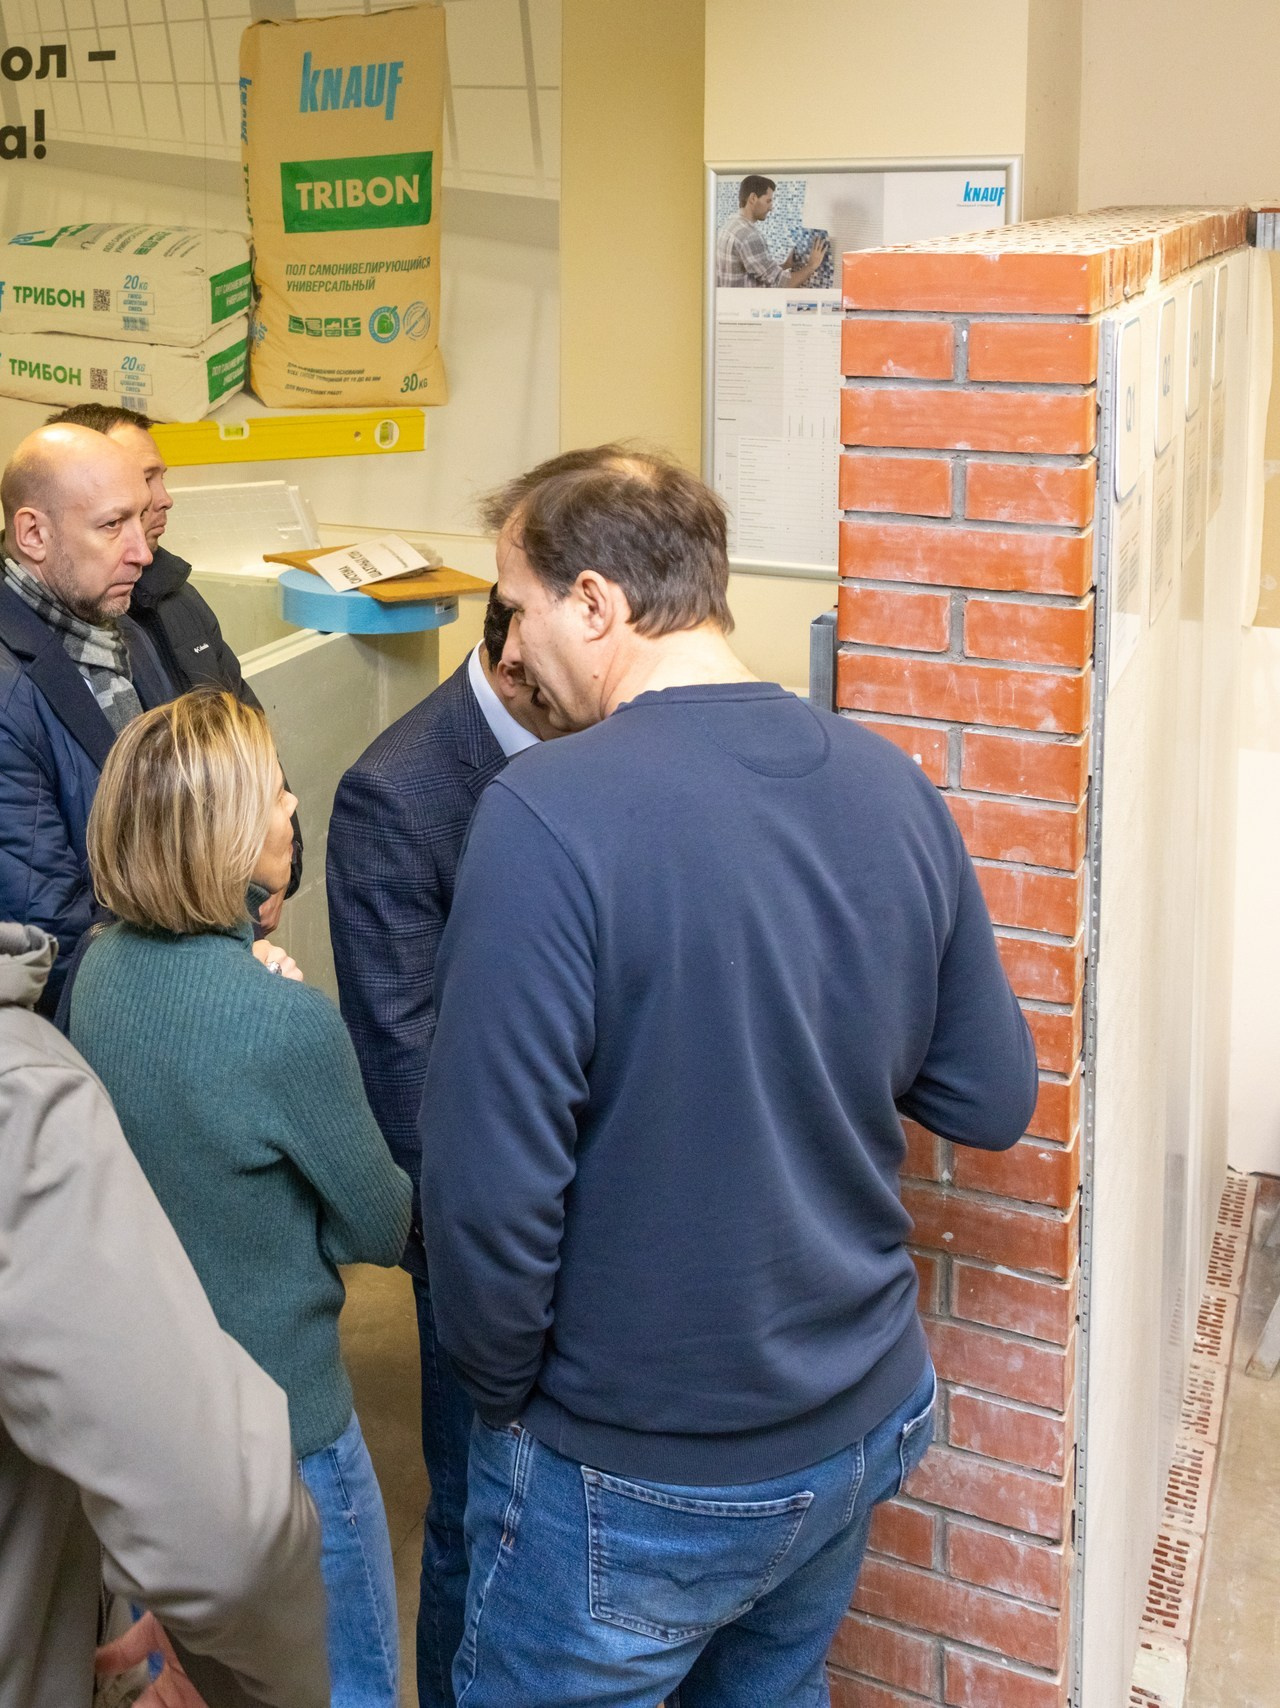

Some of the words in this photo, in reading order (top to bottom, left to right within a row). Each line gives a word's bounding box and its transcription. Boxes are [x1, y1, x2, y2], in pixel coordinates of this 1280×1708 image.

[299, 51, 404, 120] KNAUF
[295, 174, 419, 211] TRIBON
[963, 181, 1006, 207] KNAUF
[285, 264, 307, 276] ПОЛ
[309, 256, 431, 276] САМОНИВЕЛИРУЮЩИЙСЯ
[123, 275, 139, 290] 20
[286, 277, 376, 292] УНИВЕРСАЛЬНЫЙ
[13, 285, 85, 308] ТРИБОН
[9, 358, 82, 386] ТРИБОН
[121, 356, 137, 371] 20
[400, 373, 418, 393] 30
[418, 378, 428, 389] KG
